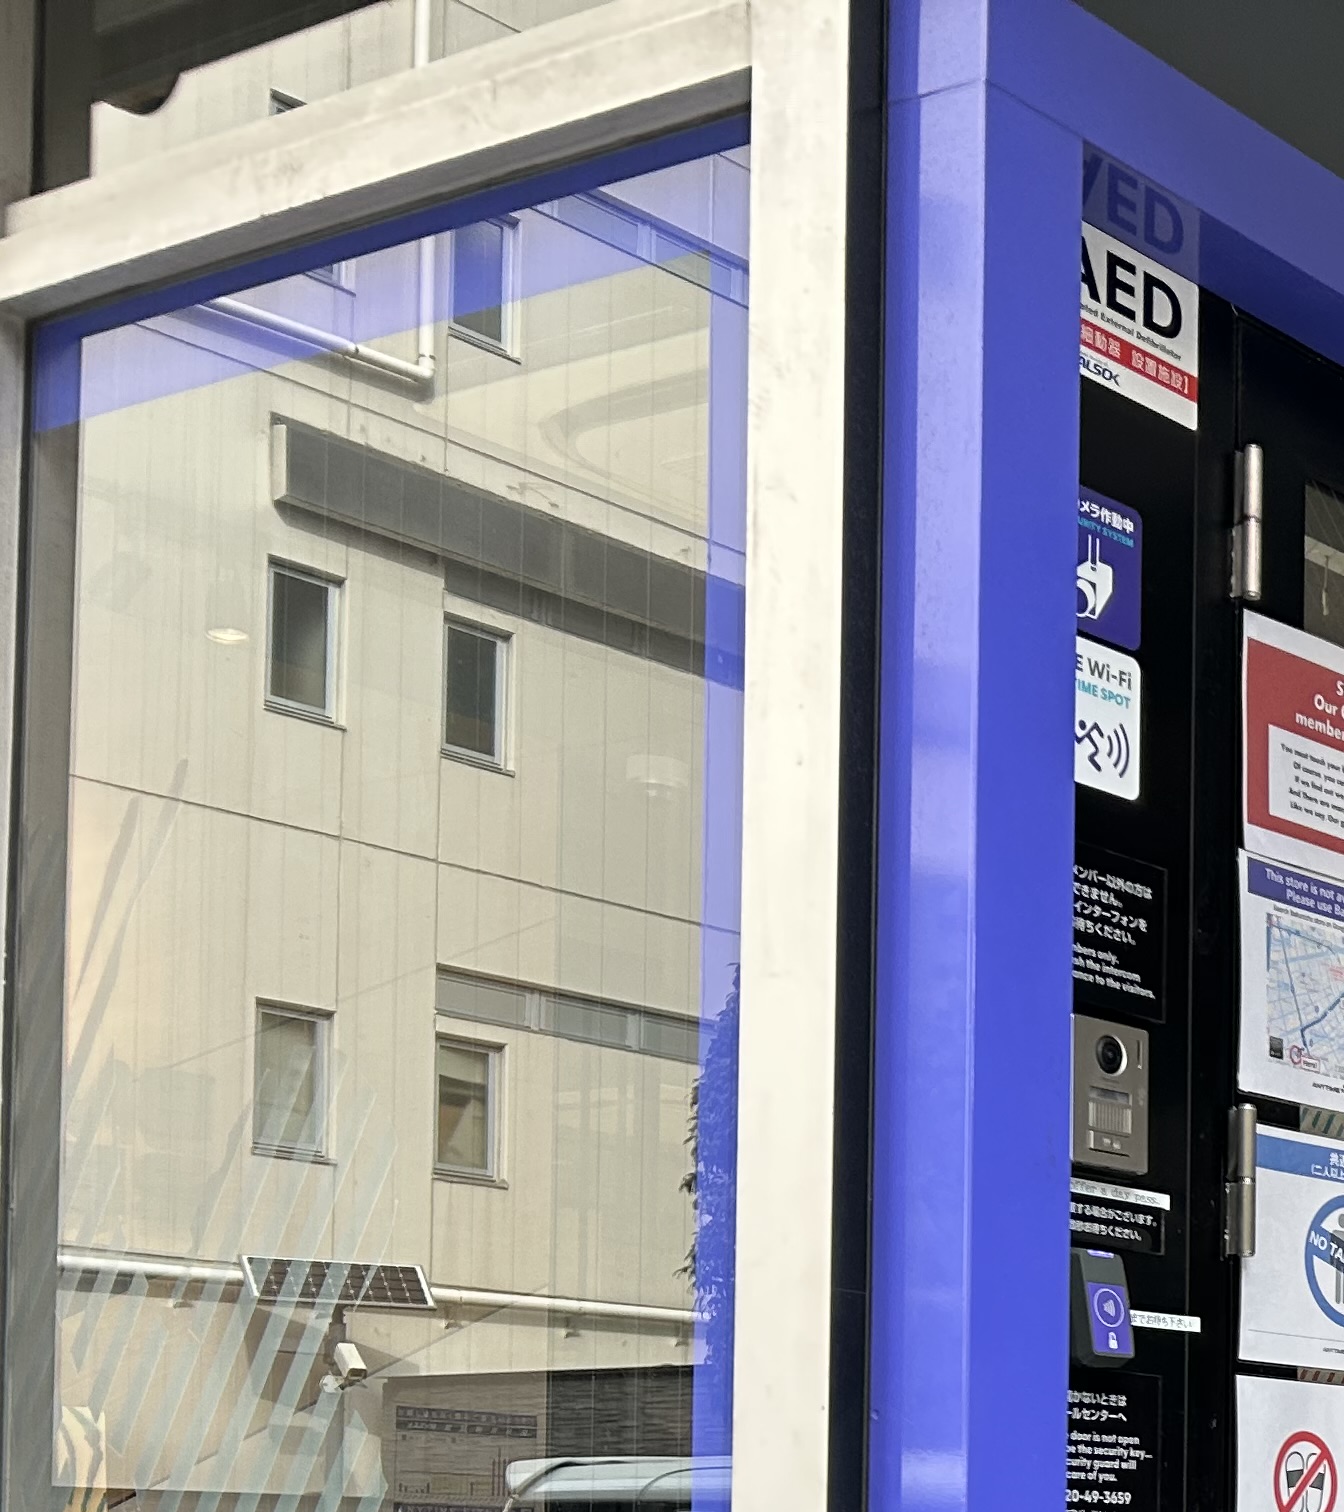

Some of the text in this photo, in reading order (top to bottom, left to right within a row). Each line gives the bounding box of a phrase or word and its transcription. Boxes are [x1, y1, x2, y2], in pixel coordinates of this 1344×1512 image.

[1079, 500, 1134, 534] メラ作動中
[1087, 656, 1132, 691] Wi-Fi
[1100, 688, 1131, 709] SPOT
[1314, 693, 1339, 716] Our
[1264, 867, 1284, 884] This
[1285, 874, 1309, 892] store
[1310, 882, 1318, 896] is
[1319, 887, 1335, 901] not
[1285, 888, 1315, 909] Please
[1317, 900, 1333, 913] use
[1309, 1230, 1328, 1250] NO
